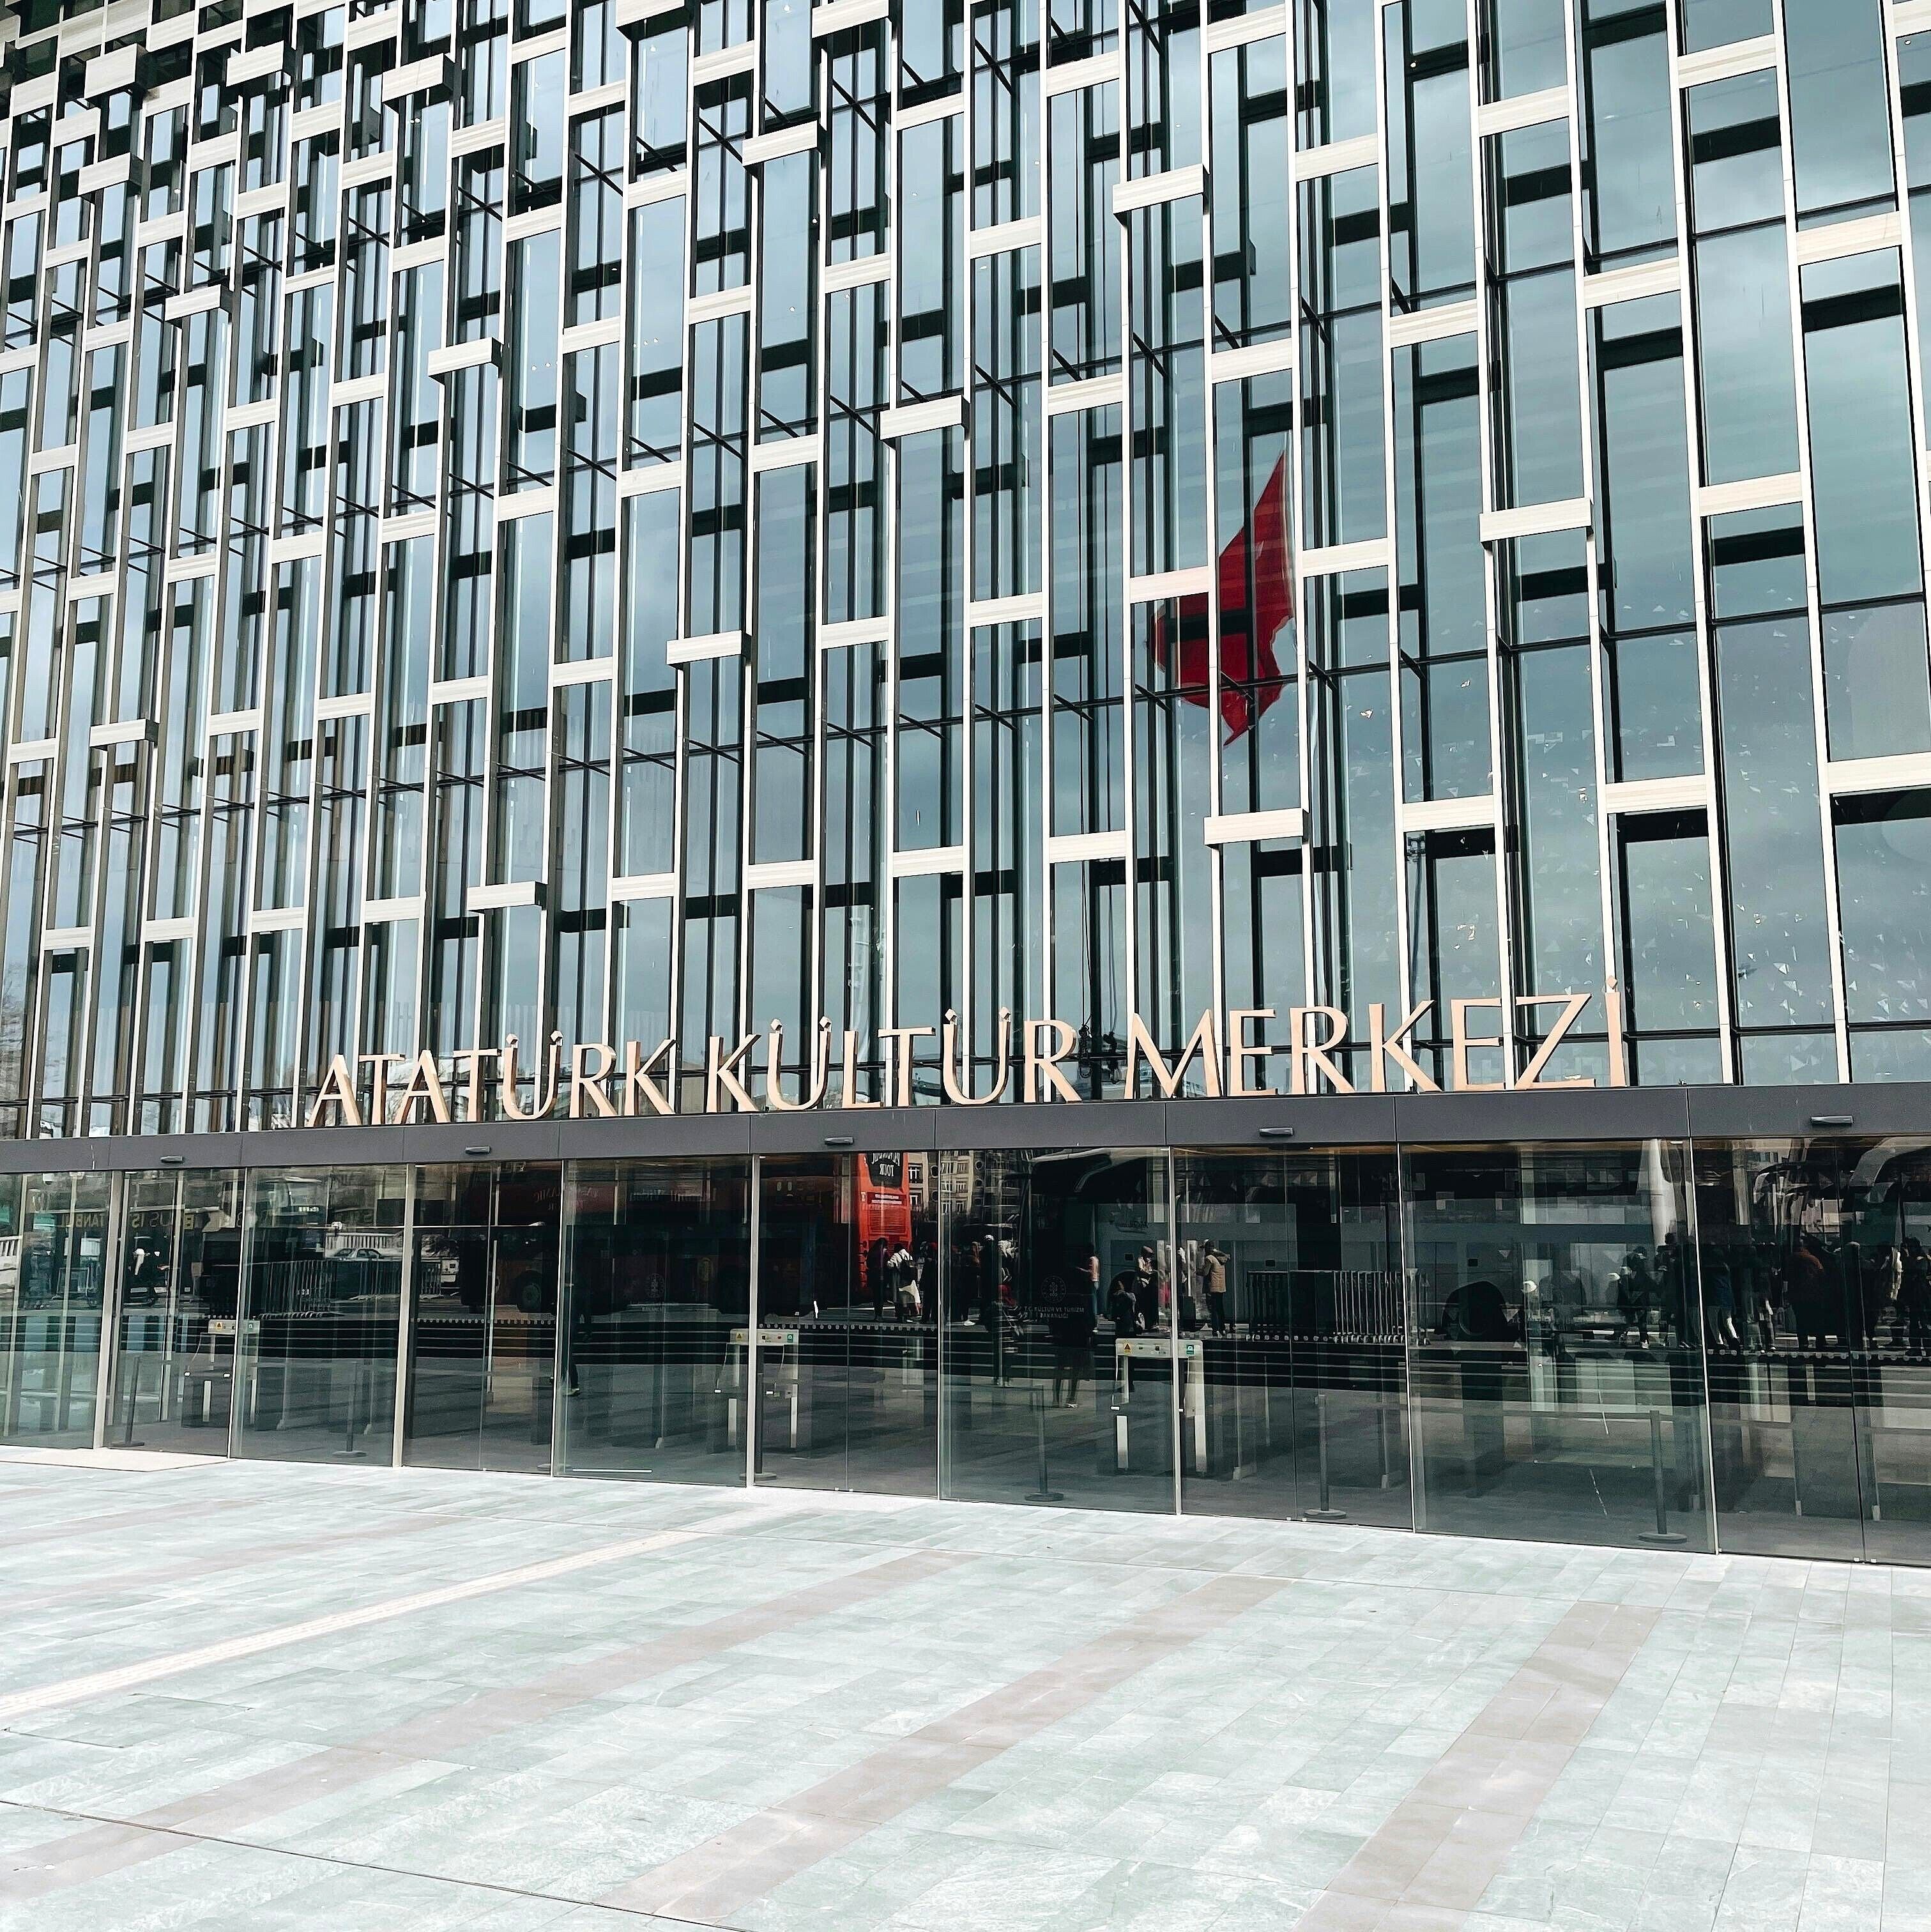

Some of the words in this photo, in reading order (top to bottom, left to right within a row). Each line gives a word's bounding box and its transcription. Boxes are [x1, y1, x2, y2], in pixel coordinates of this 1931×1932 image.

[308, 1030, 677, 1126] ATATÜRK
[706, 1006, 1082, 1113] KÜLTÜR
[1124, 975, 1626, 1099] MERKEZİ
